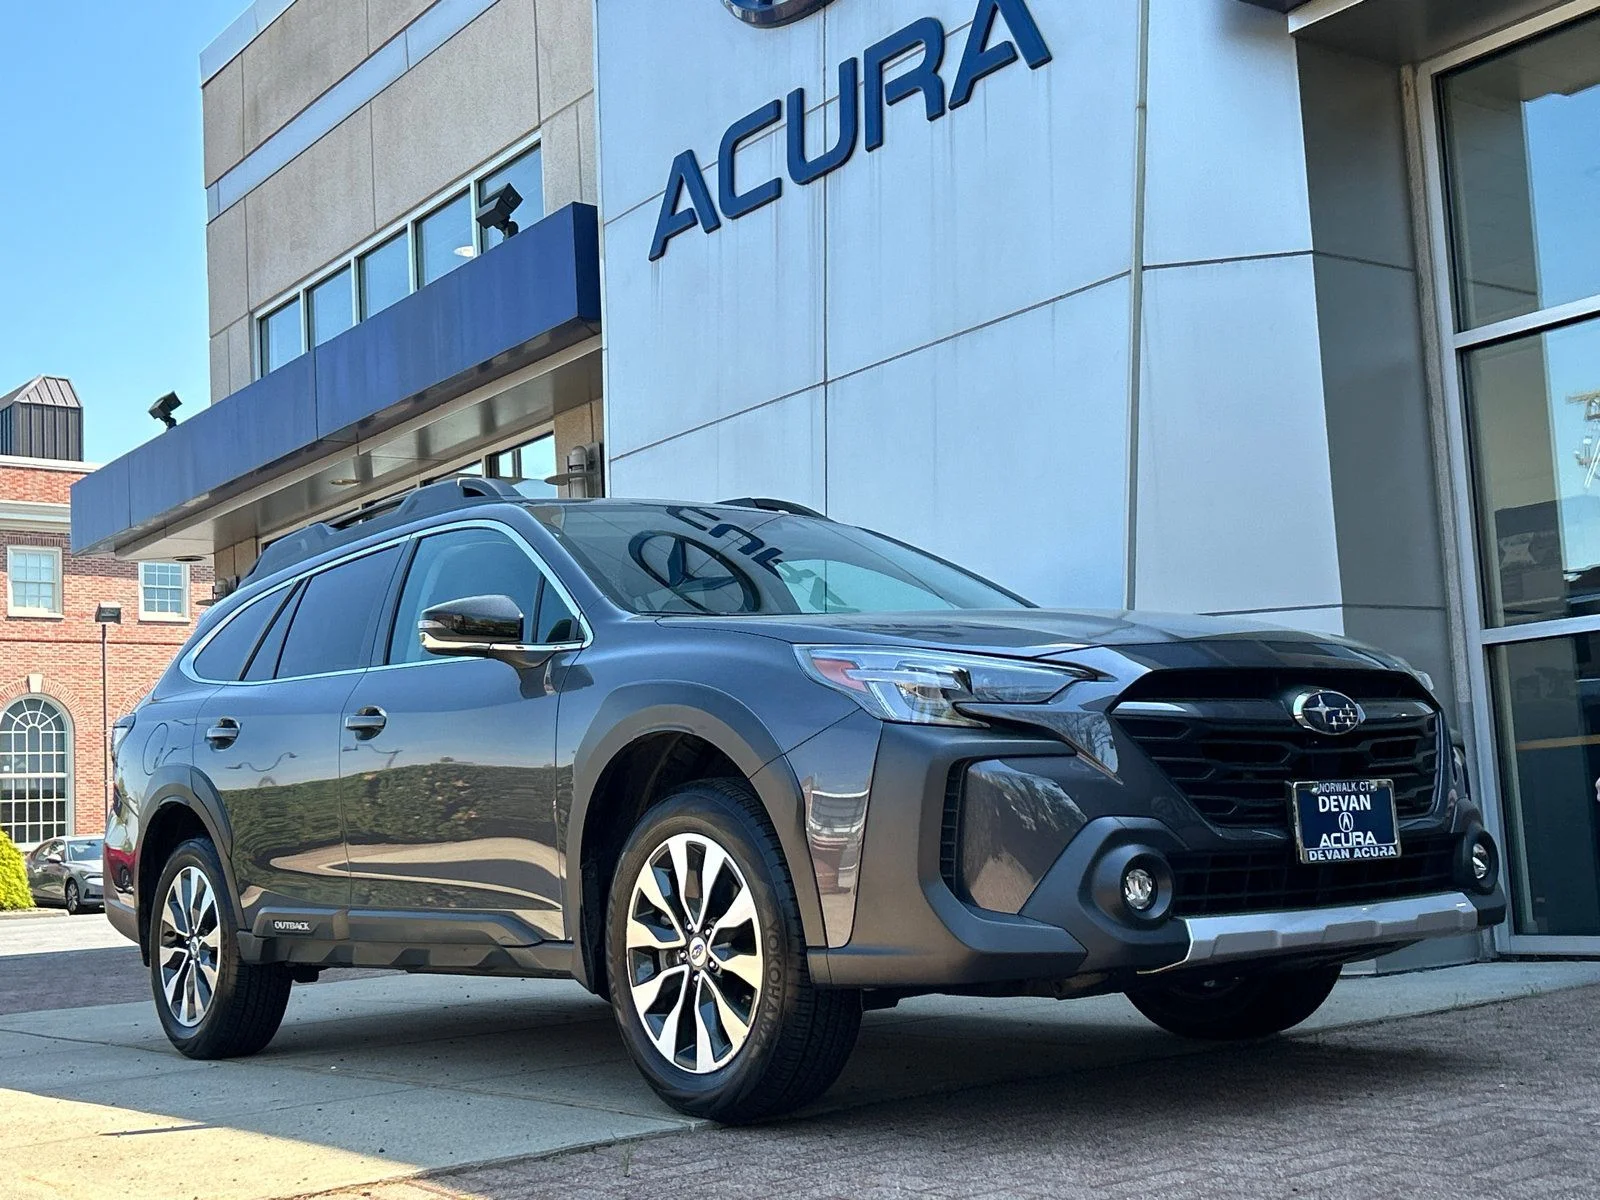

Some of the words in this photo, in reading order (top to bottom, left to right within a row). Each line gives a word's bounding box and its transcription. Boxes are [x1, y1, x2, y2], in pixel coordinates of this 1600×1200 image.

[649, 0, 1052, 261] ACURA
[1319, 782, 1357, 793] NORWALK
[1359, 782, 1370, 792] CT
[1318, 794, 1371, 813] DEVAN
[1320, 831, 1377, 848] ACURA
[1308, 848, 1350, 861] DEVAN
[1353, 846, 1397, 859] ACURA
[274, 921, 310, 931] OUTBACK
